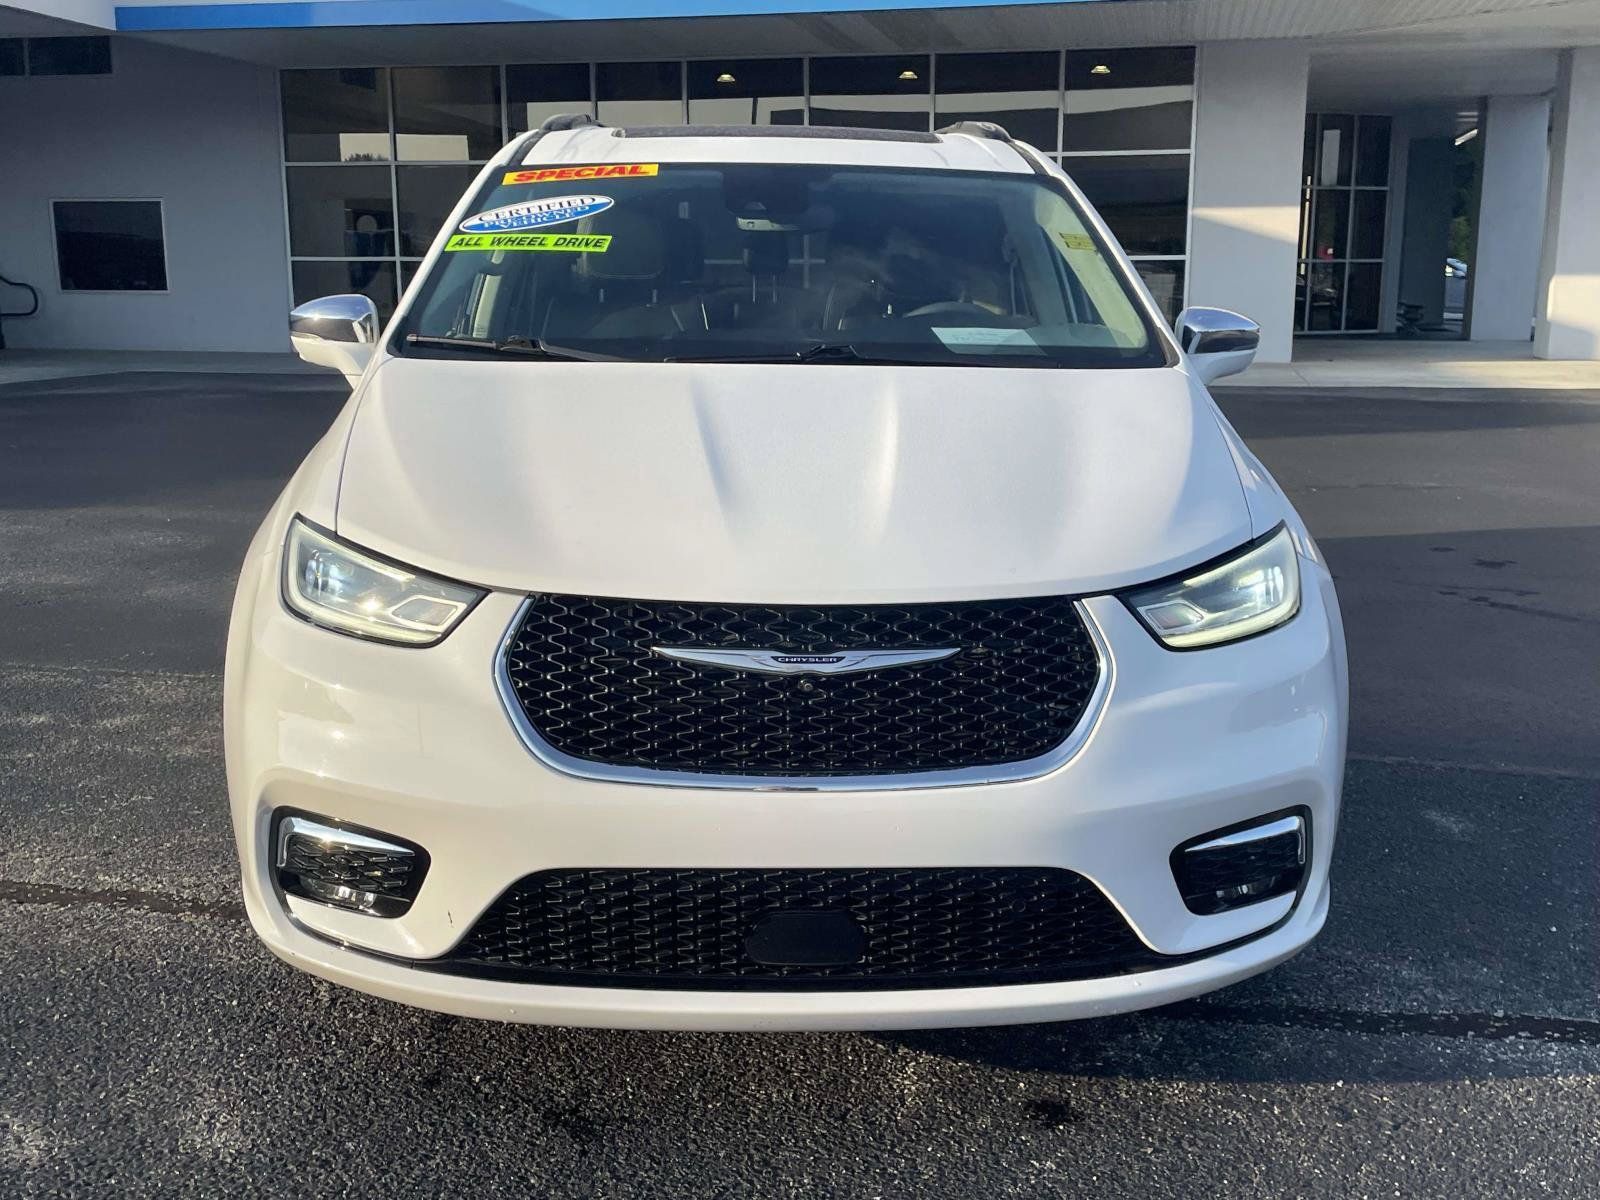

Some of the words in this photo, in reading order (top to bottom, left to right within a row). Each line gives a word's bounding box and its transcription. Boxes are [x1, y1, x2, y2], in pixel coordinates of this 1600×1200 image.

[513, 165, 651, 183] SPECIAL
[478, 197, 596, 222] CERTIFIED
[499, 212, 576, 229] VEHICLE
[452, 236, 484, 247] ALL
[490, 236, 548, 248] WHEEL
[552, 236, 607, 249] DRIVE
